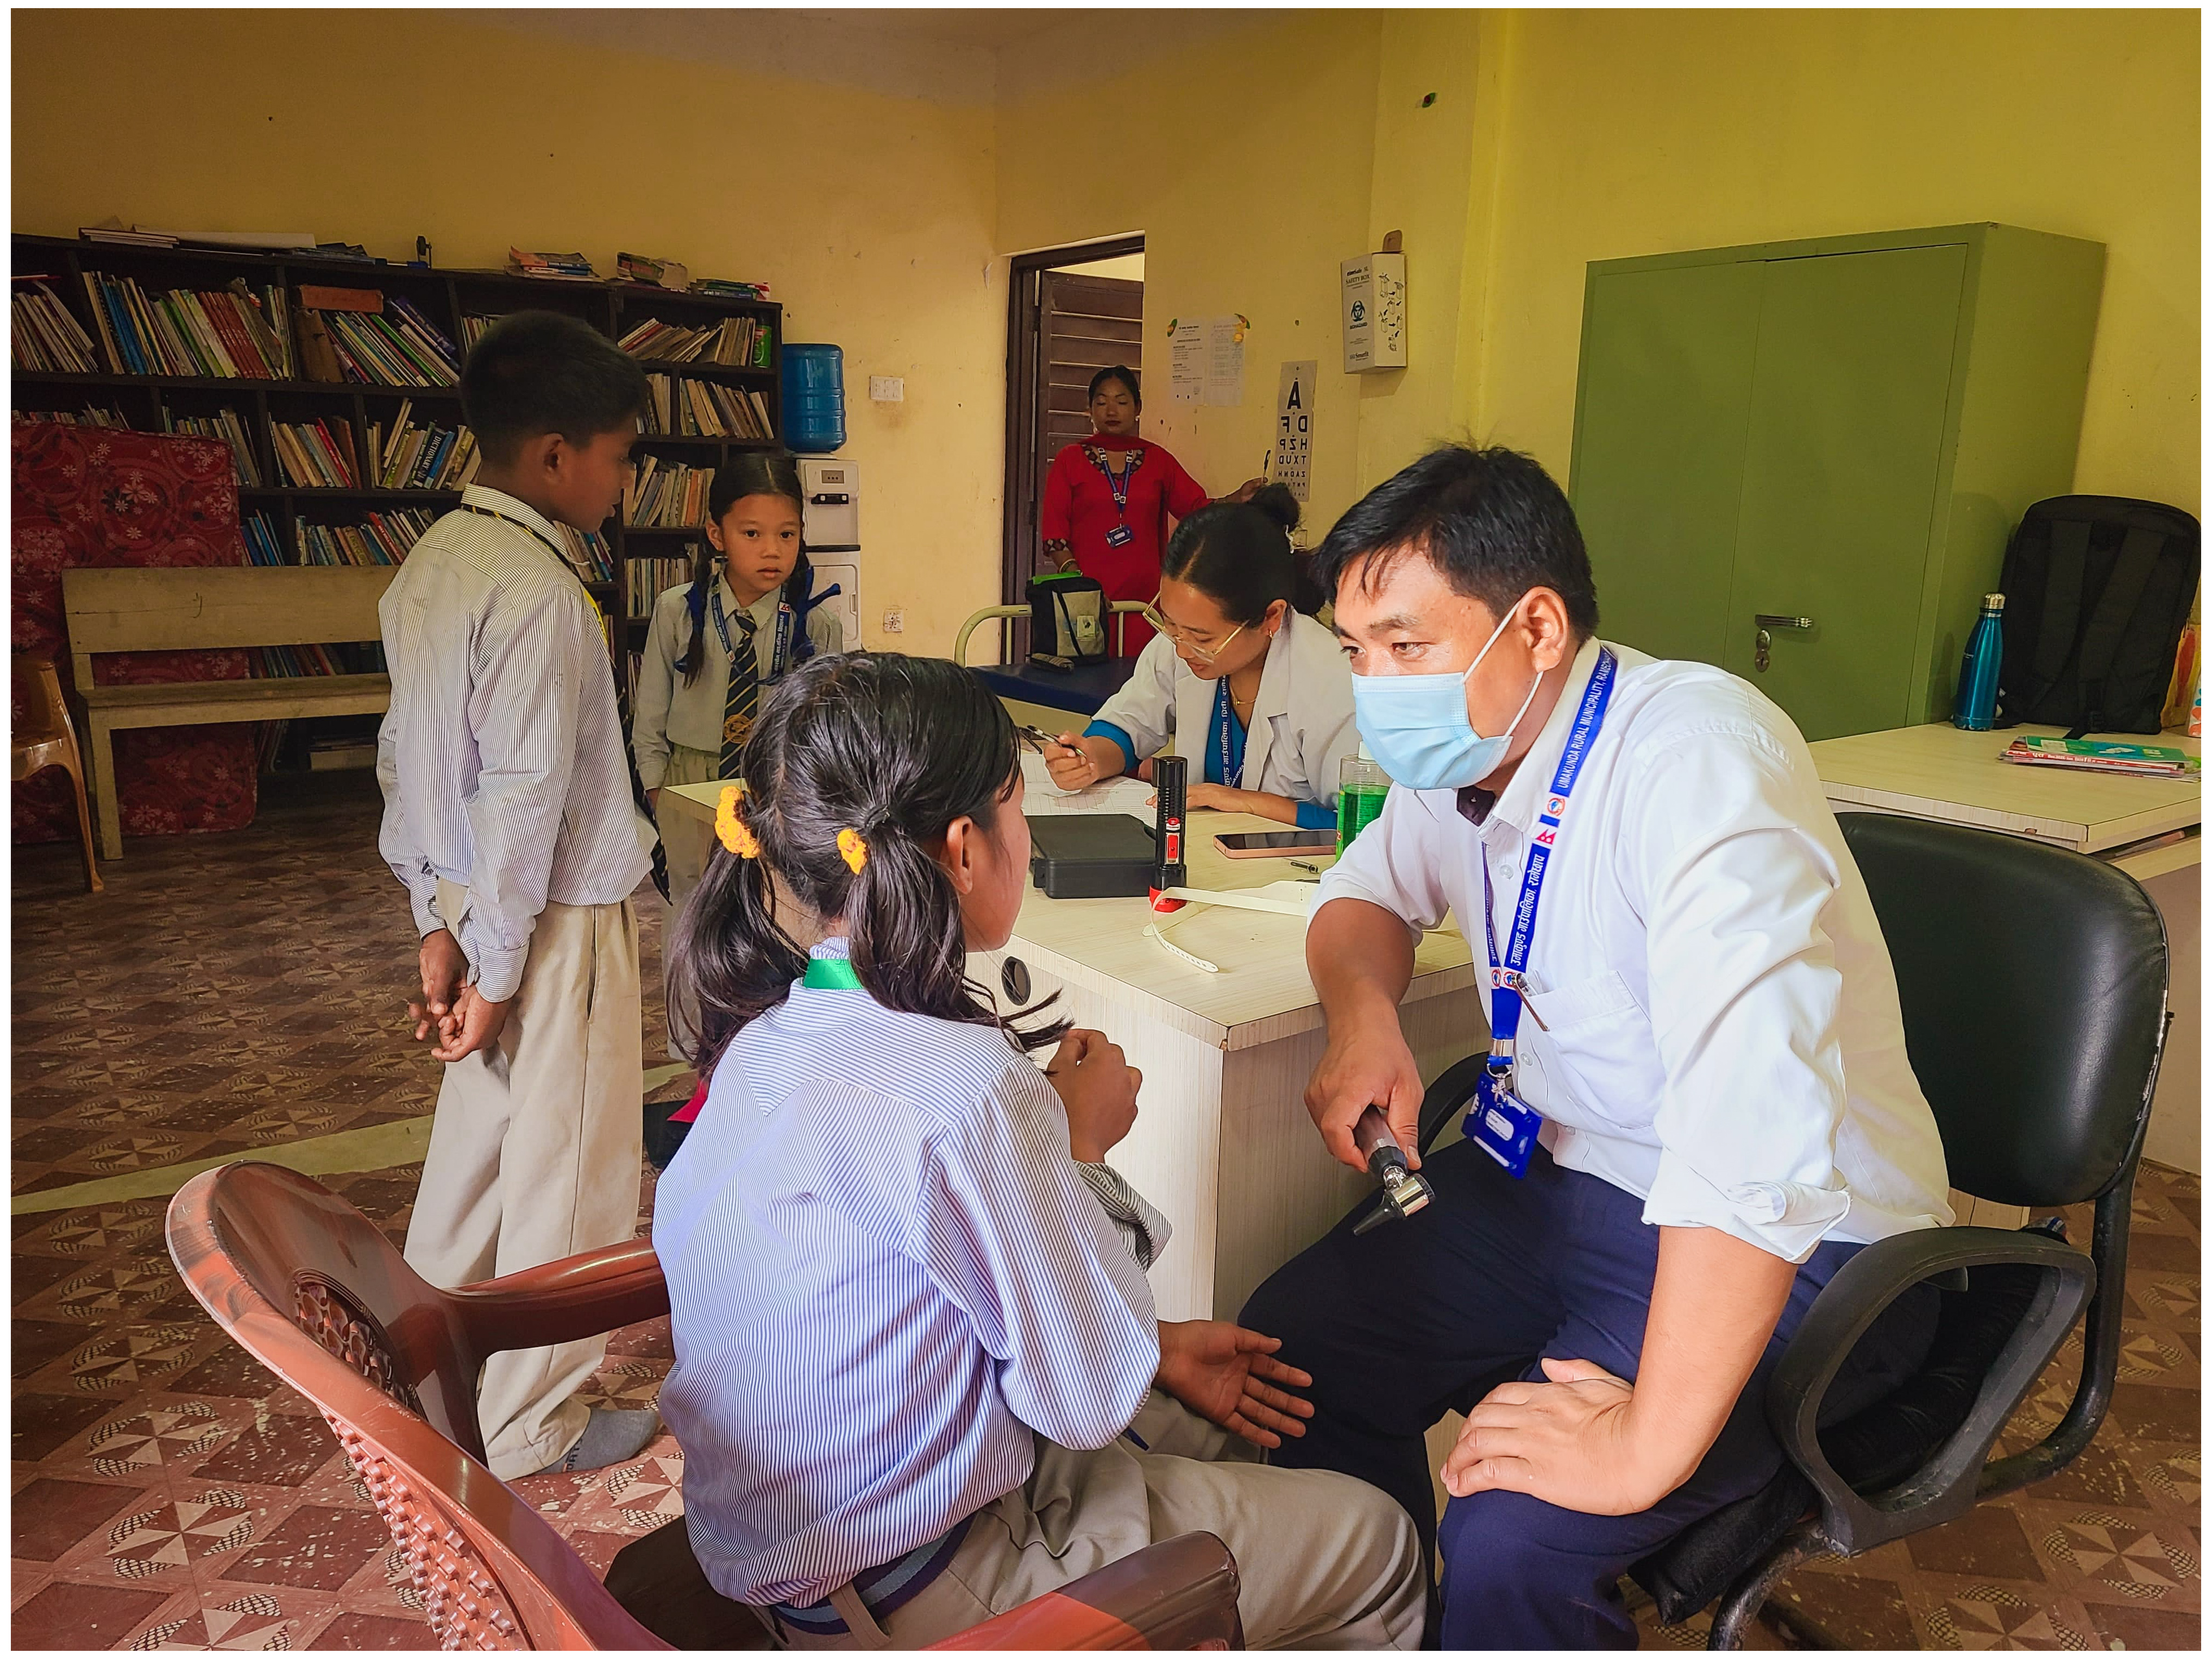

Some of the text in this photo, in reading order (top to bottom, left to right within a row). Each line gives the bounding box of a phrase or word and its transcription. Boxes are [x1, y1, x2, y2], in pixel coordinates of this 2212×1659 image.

[422, 436, 442, 470] DICTIONARY
[1579, 680, 1606, 727] MUNICIPALITY,
[1571, 723, 1589, 751] RURAL
[1557, 752, 1580, 788] UMAKUNDA
[1511, 932, 1527, 966] उमाकुण्ड
[1527, 854, 1545, 886] रामेछाप
